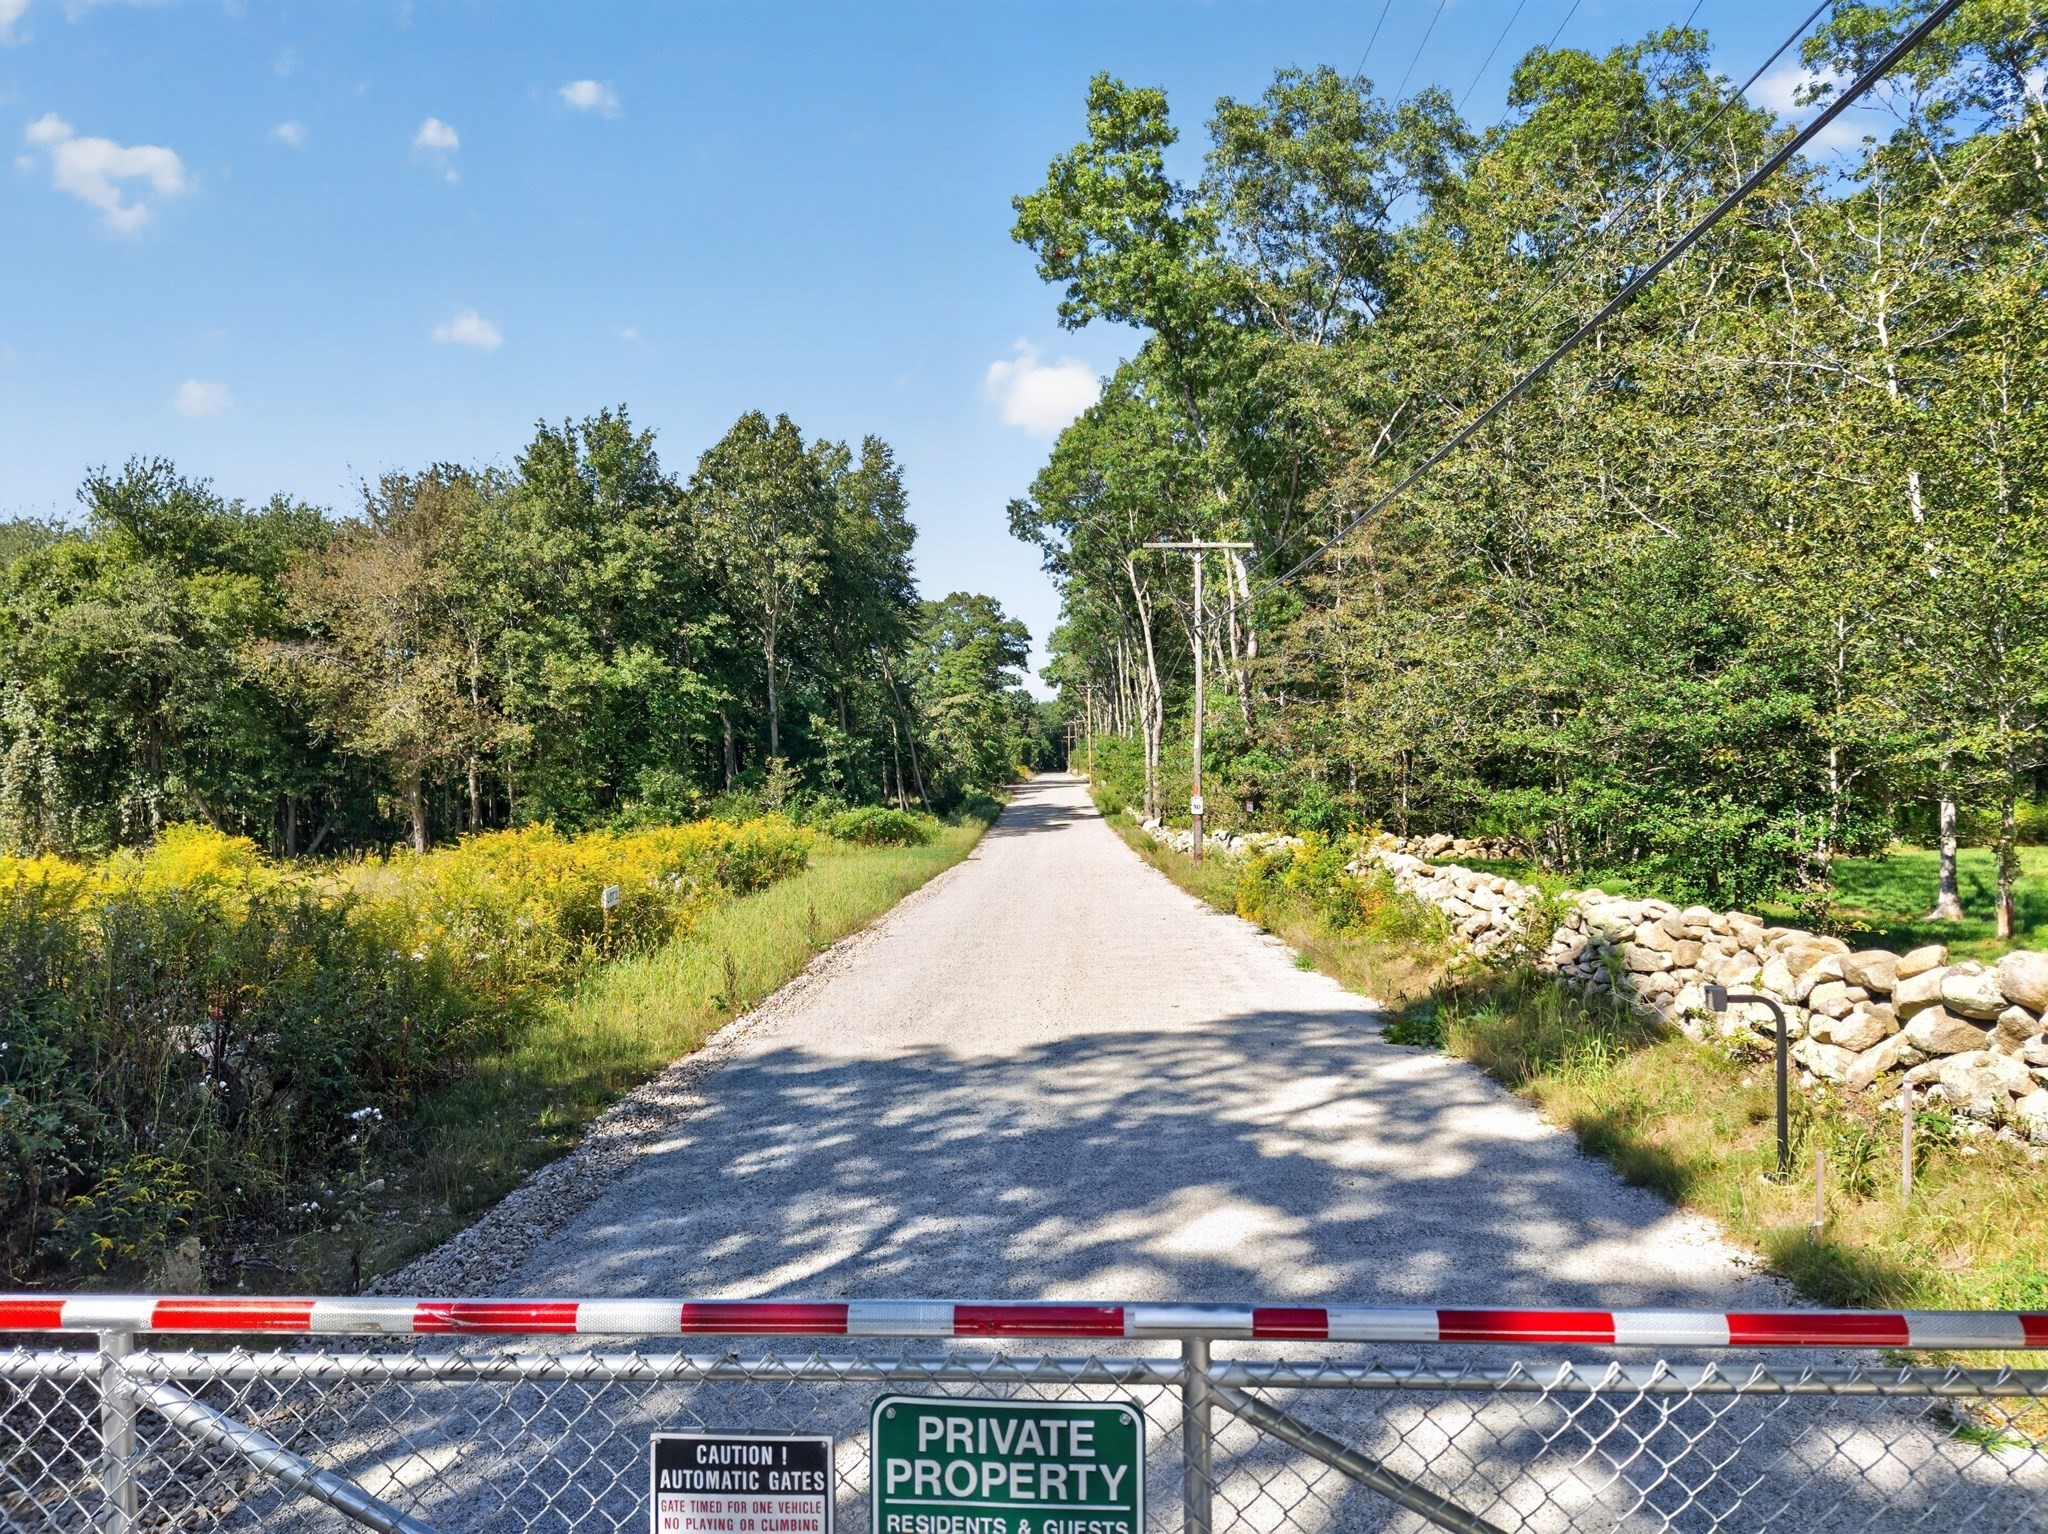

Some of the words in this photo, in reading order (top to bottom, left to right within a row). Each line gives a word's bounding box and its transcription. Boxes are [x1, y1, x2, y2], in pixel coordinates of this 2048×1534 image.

[918, 1415, 1096, 1457] PRIVATE
[696, 1444, 773, 1466] CAUTION
[782, 1446, 787, 1466] !
[659, 1469, 760, 1491] AUTOMATIC
[768, 1471, 825, 1491] GATES
[886, 1457, 1128, 1501] PROPERTY
[661, 1499, 685, 1513] GATE
[690, 1500, 722, 1513] TIMED
[727, 1501, 747, 1514] FOR
[752, 1501, 773, 1514] ONE
[778, 1501, 822, 1514] VEHICLE
[664, 1517, 680, 1530] NO
[685, 1517, 734, 1531] PLAYING
[740, 1518, 755, 1532] OR
[761, 1518, 819, 1532] CLIMBING
[887, 1514, 1007, 1534] RESIDENTS
[1018, 1519, 1031, 1534] &
[1043, 1519, 1129, 1534] GUESTS
